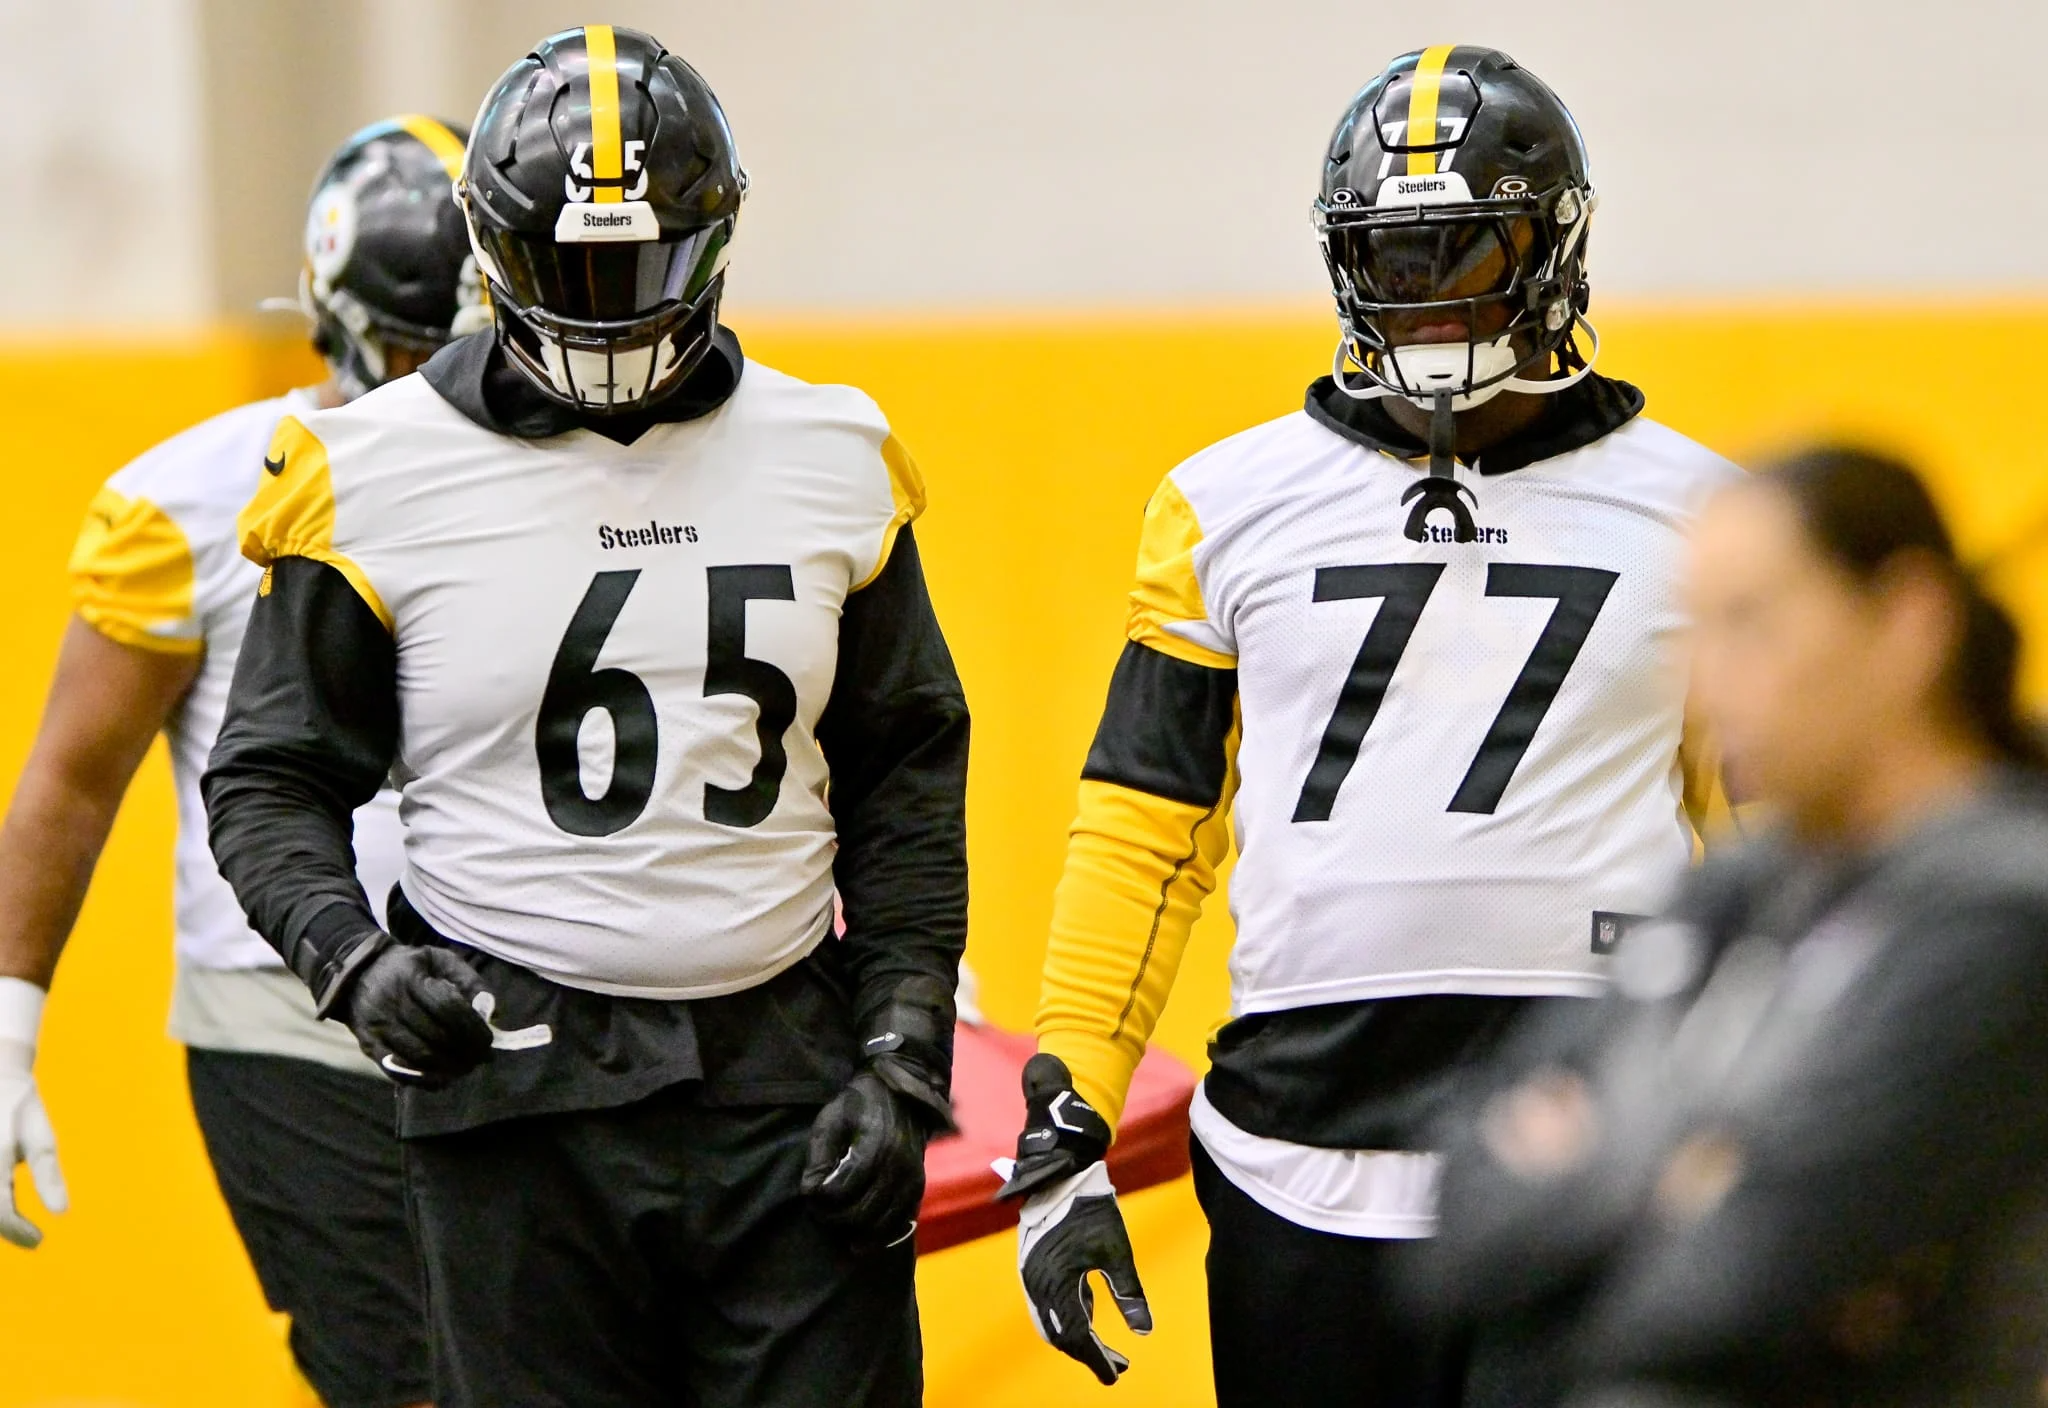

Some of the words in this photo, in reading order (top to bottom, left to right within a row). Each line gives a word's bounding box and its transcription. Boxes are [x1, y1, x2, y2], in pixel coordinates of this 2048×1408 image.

[1398, 179, 1446, 194] Steelers
[583, 212, 632, 227] Steelers
[599, 520, 699, 549] Steelers
[1416, 523, 1508, 544] Steers
[535, 564, 798, 837] 65
[1291, 562, 1621, 823] 77
